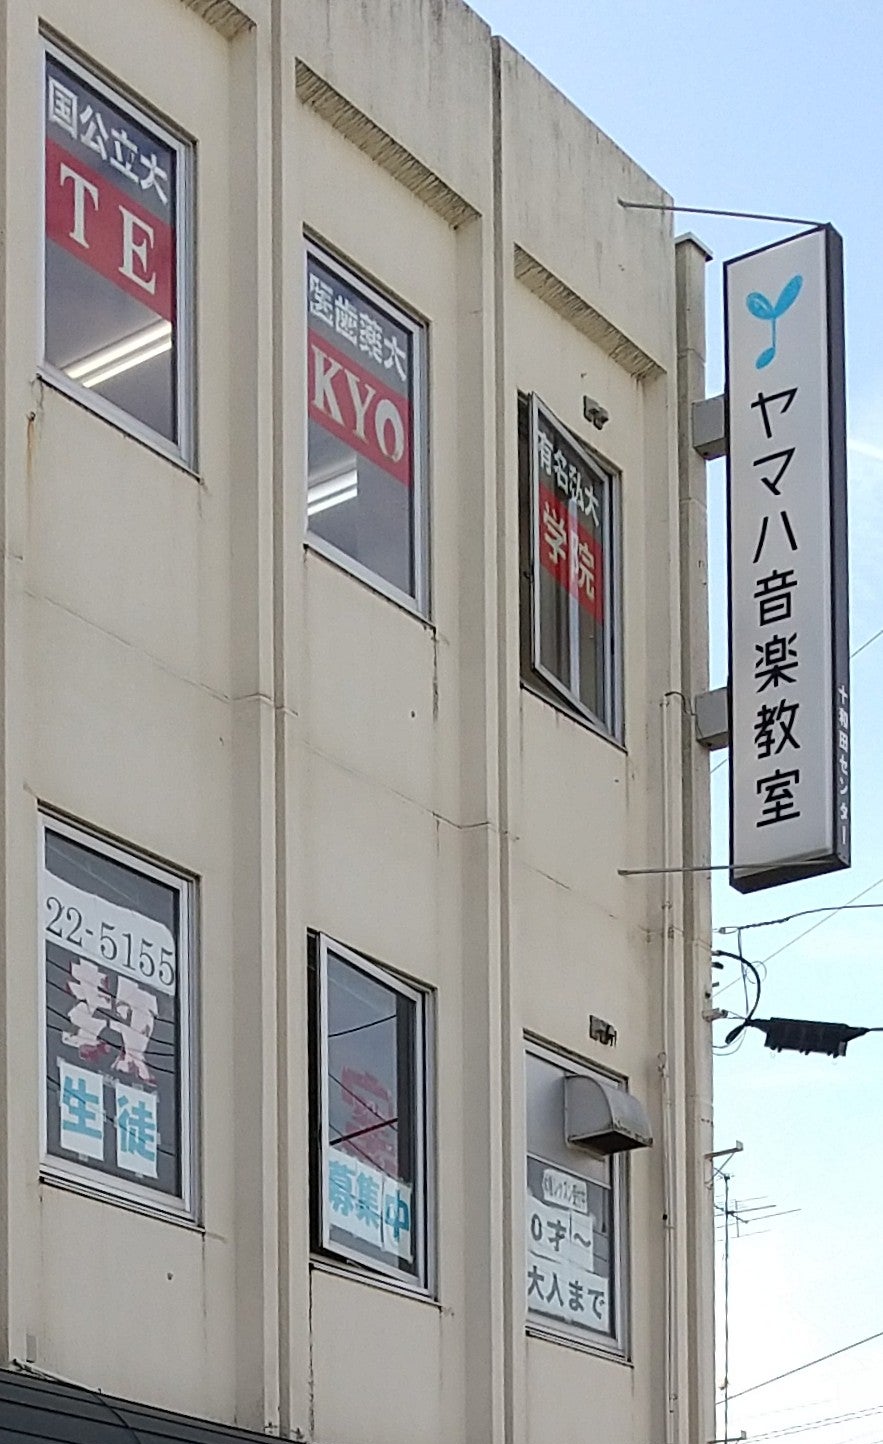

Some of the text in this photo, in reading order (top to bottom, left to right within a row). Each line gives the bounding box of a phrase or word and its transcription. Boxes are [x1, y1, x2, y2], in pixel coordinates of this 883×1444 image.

[47, 75, 168, 205] 国公立大
[309, 273, 406, 382] 医歯薬大
[311, 344, 405, 463] KYO
[543, 501, 595, 599] 学院
[750, 387, 801, 829] ヤマハ音楽教室
[45, 897, 176, 986] 22-5155
[62, 1076, 156, 1162] 生徒
[329, 1160, 410, 1243] 募集中
[528, 1265, 605, 1320] 大人まで
